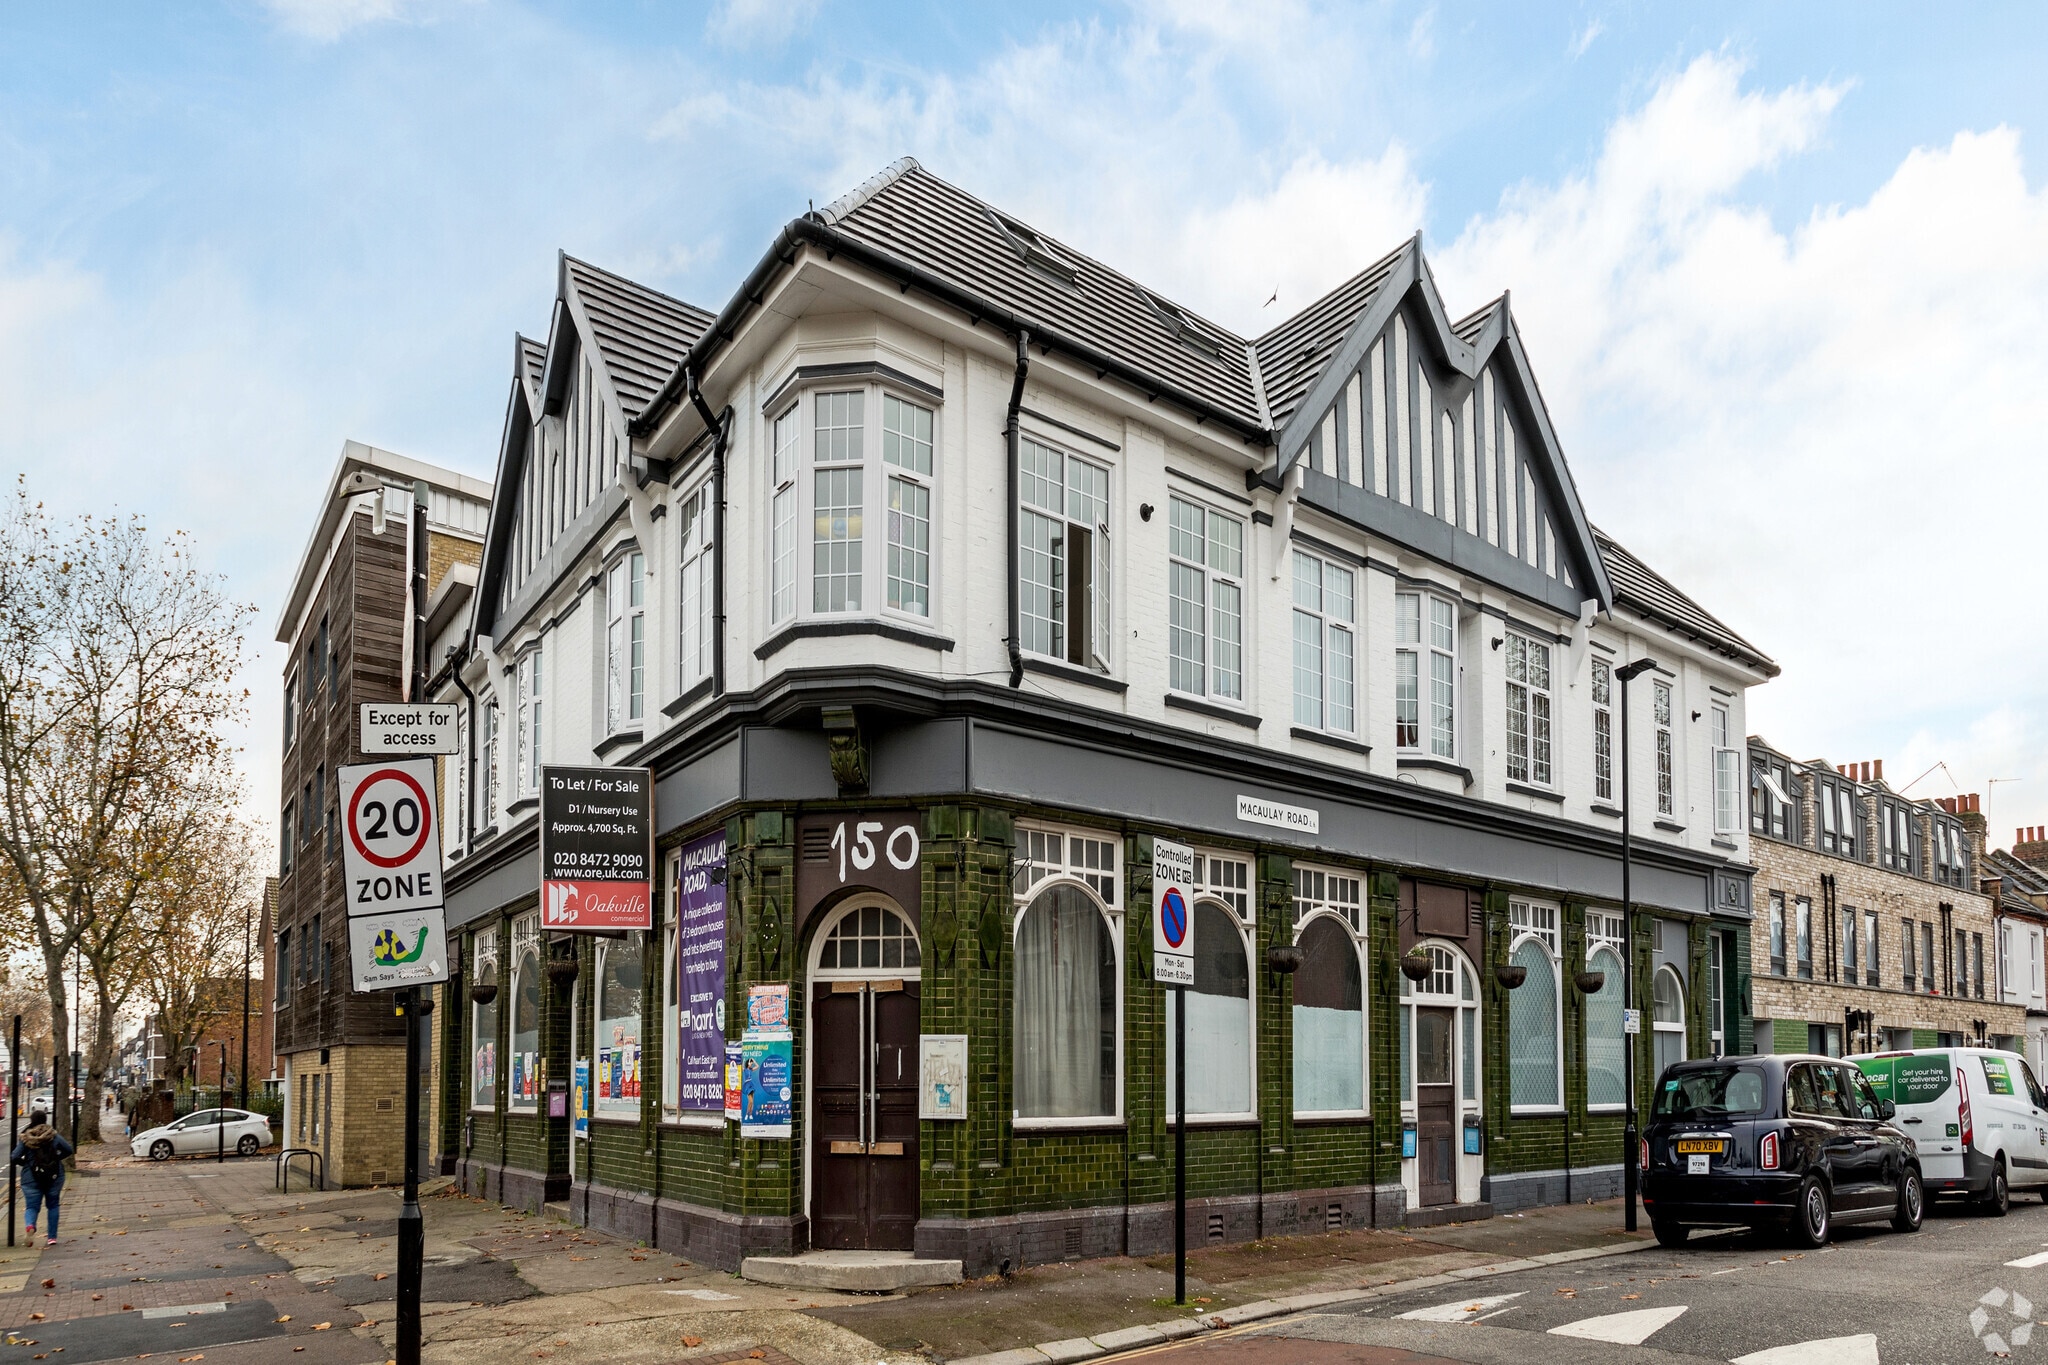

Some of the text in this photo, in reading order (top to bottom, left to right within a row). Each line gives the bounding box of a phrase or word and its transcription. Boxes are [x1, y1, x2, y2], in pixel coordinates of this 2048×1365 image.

[368, 710, 450, 728] Except for
[383, 733, 436, 745] access
[550, 777, 564, 789] To
[567, 778, 585, 790] Let
[594, 779, 613, 791] For
[616, 780, 639, 792] Sale
[568, 804, 580, 814] D1
[588, 805, 620, 817] Nursery
[622, 807, 638, 816] Use
[1240, 802, 1284, 820] MACAULAY
[1288, 811, 1308, 826] ROAD
[362, 798, 419, 840] 20
[552, 822, 638, 835] Approx. 4,700 Sq. Ft.
[554, 852, 642, 866] 020 8472 9090
[831, 822, 920, 882] 150
[1156, 844, 1192, 865] Controlled
[554, 867, 643, 879] www.ore.uk.com
[1156, 863, 1181, 882] ZONE
[356, 872, 433, 903] ZONE
[585, 894, 644, 912] Oakville
[380, 973, 394, 981] Says
[1914, 1068, 1928, 1078] your
[682, 1084, 693, 1098] 020
[694, 1084, 708, 1099] 8471
[708, 1084, 724, 1099] 8282
[1681, 1142, 1718, 1150] LN70 XBV
